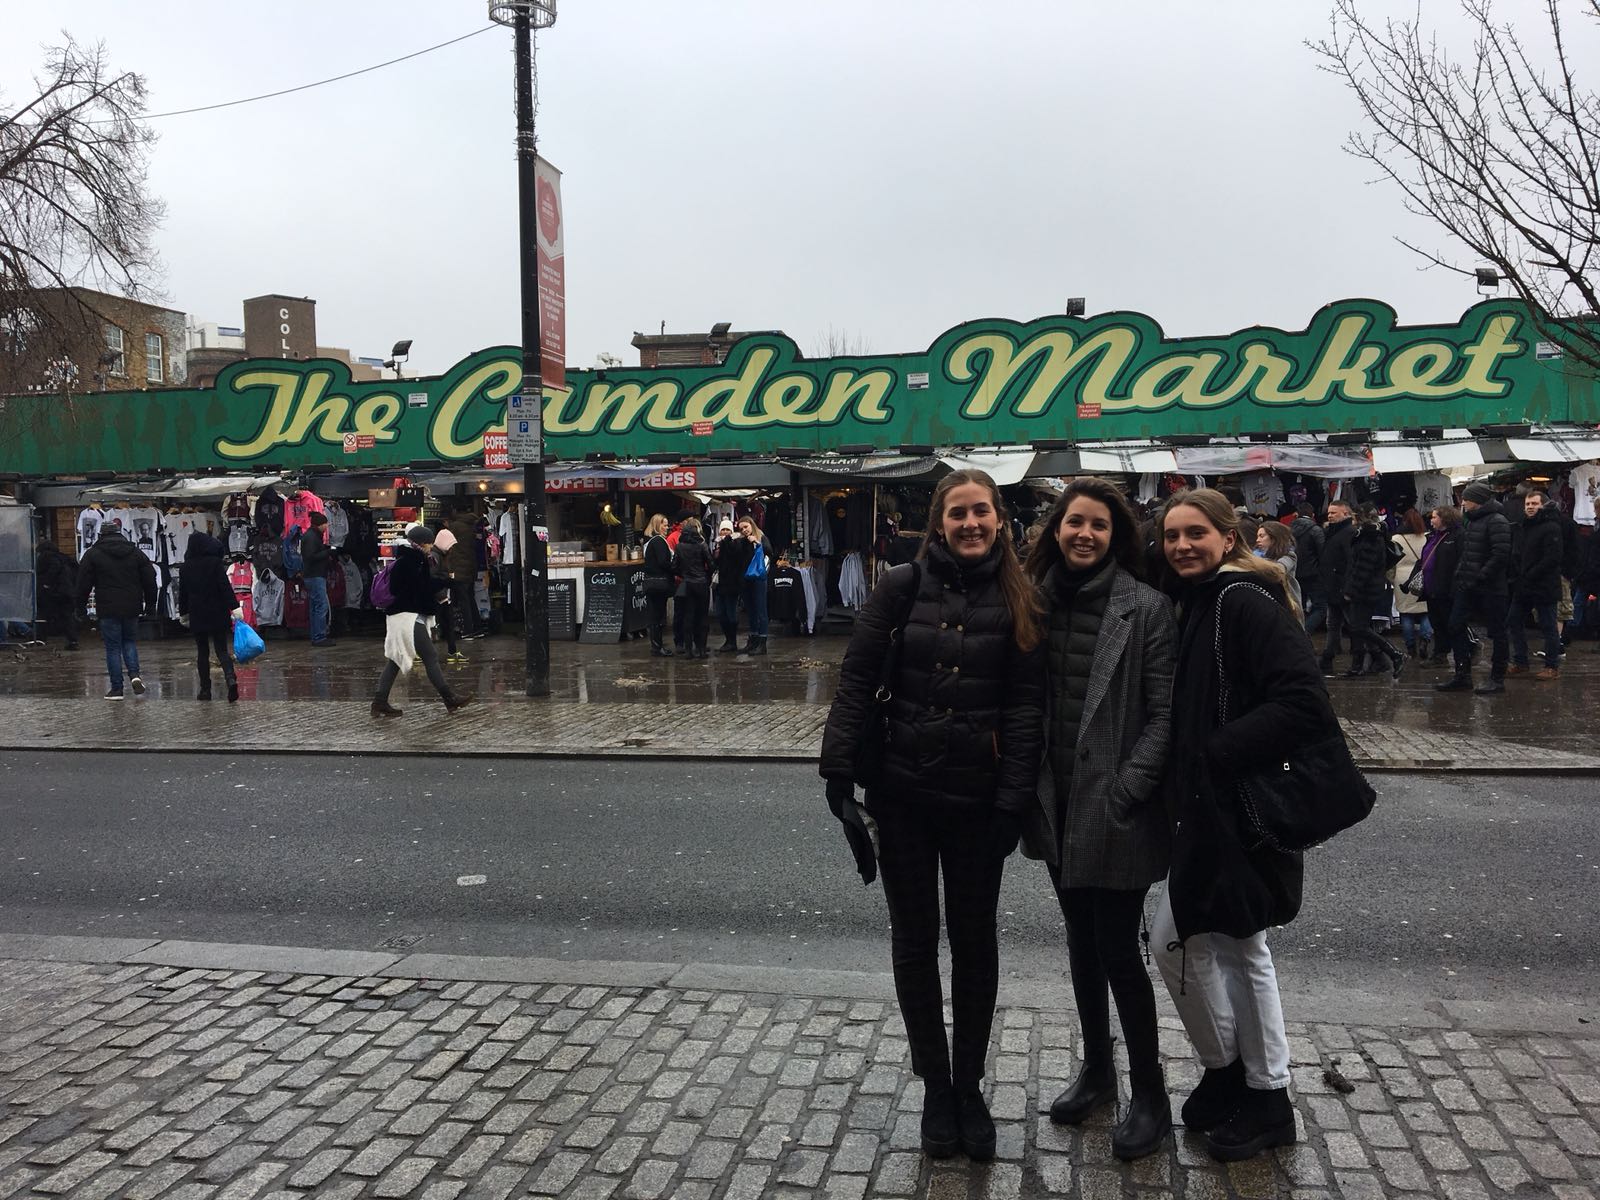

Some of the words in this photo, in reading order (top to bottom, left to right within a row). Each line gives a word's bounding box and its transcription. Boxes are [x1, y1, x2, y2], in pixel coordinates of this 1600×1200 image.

[279, 308, 290, 359] COL
[216, 371, 400, 458] The
[947, 314, 1521, 417] Market
[521, 423, 528, 432] P
[484, 436, 508, 450] COFFE
[626, 471, 696, 488] CREPES
